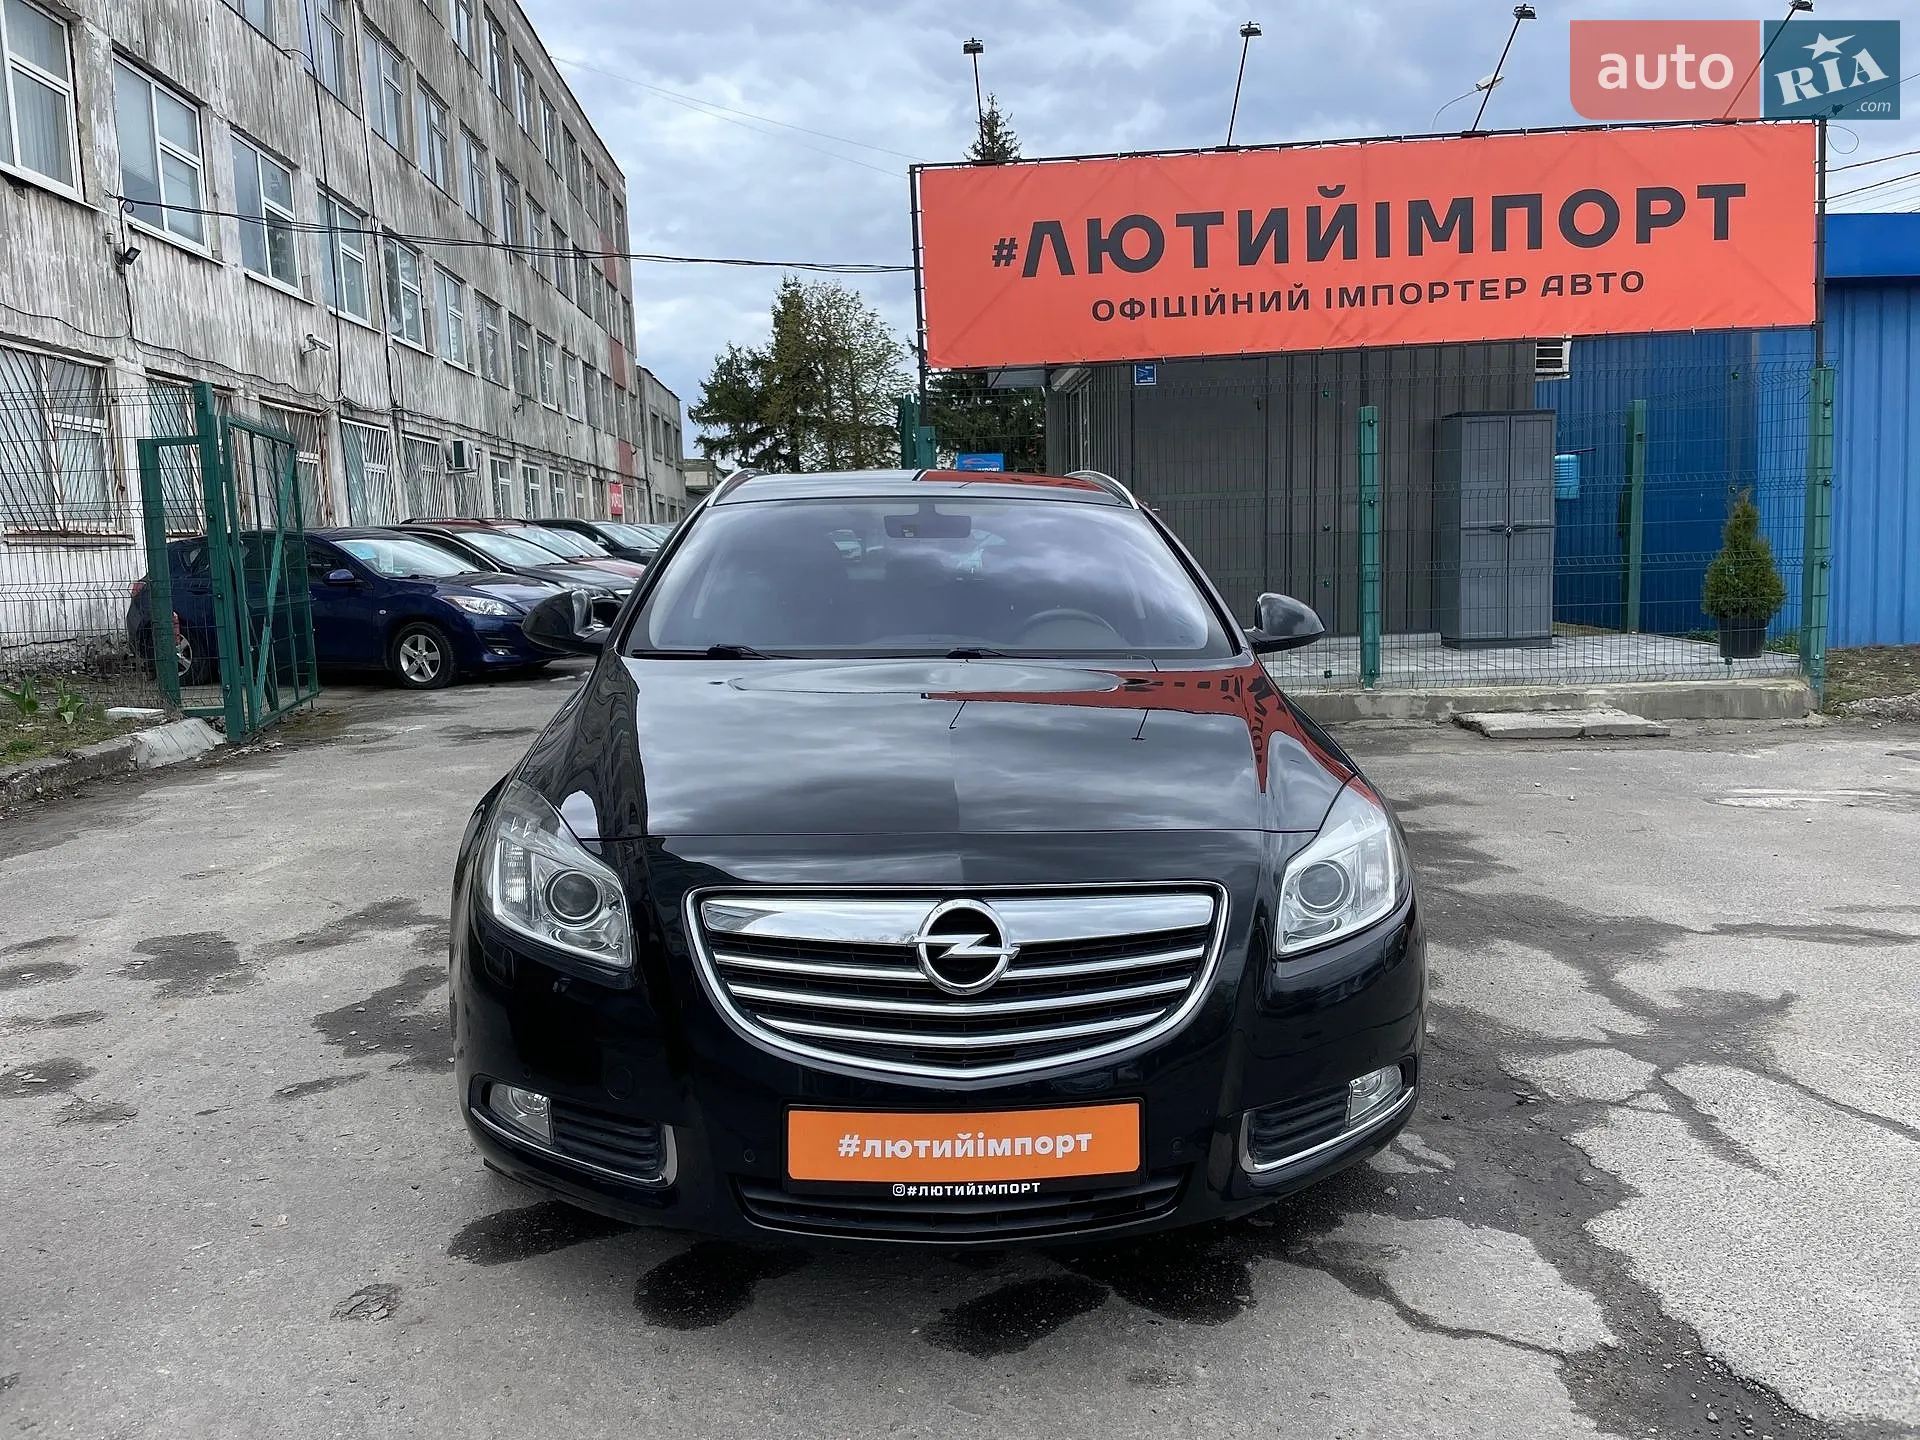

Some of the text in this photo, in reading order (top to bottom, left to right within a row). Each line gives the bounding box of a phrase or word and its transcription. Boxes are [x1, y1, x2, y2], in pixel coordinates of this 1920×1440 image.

[992, 184, 1746, 278] #ЛЮТИЙІМПОРТ
[1091, 270, 1645, 322] ОФІЦІЙНИЙ ІМПОРТЕР АВТО
[838, 1131, 1093, 1159] #лютийімпорт
